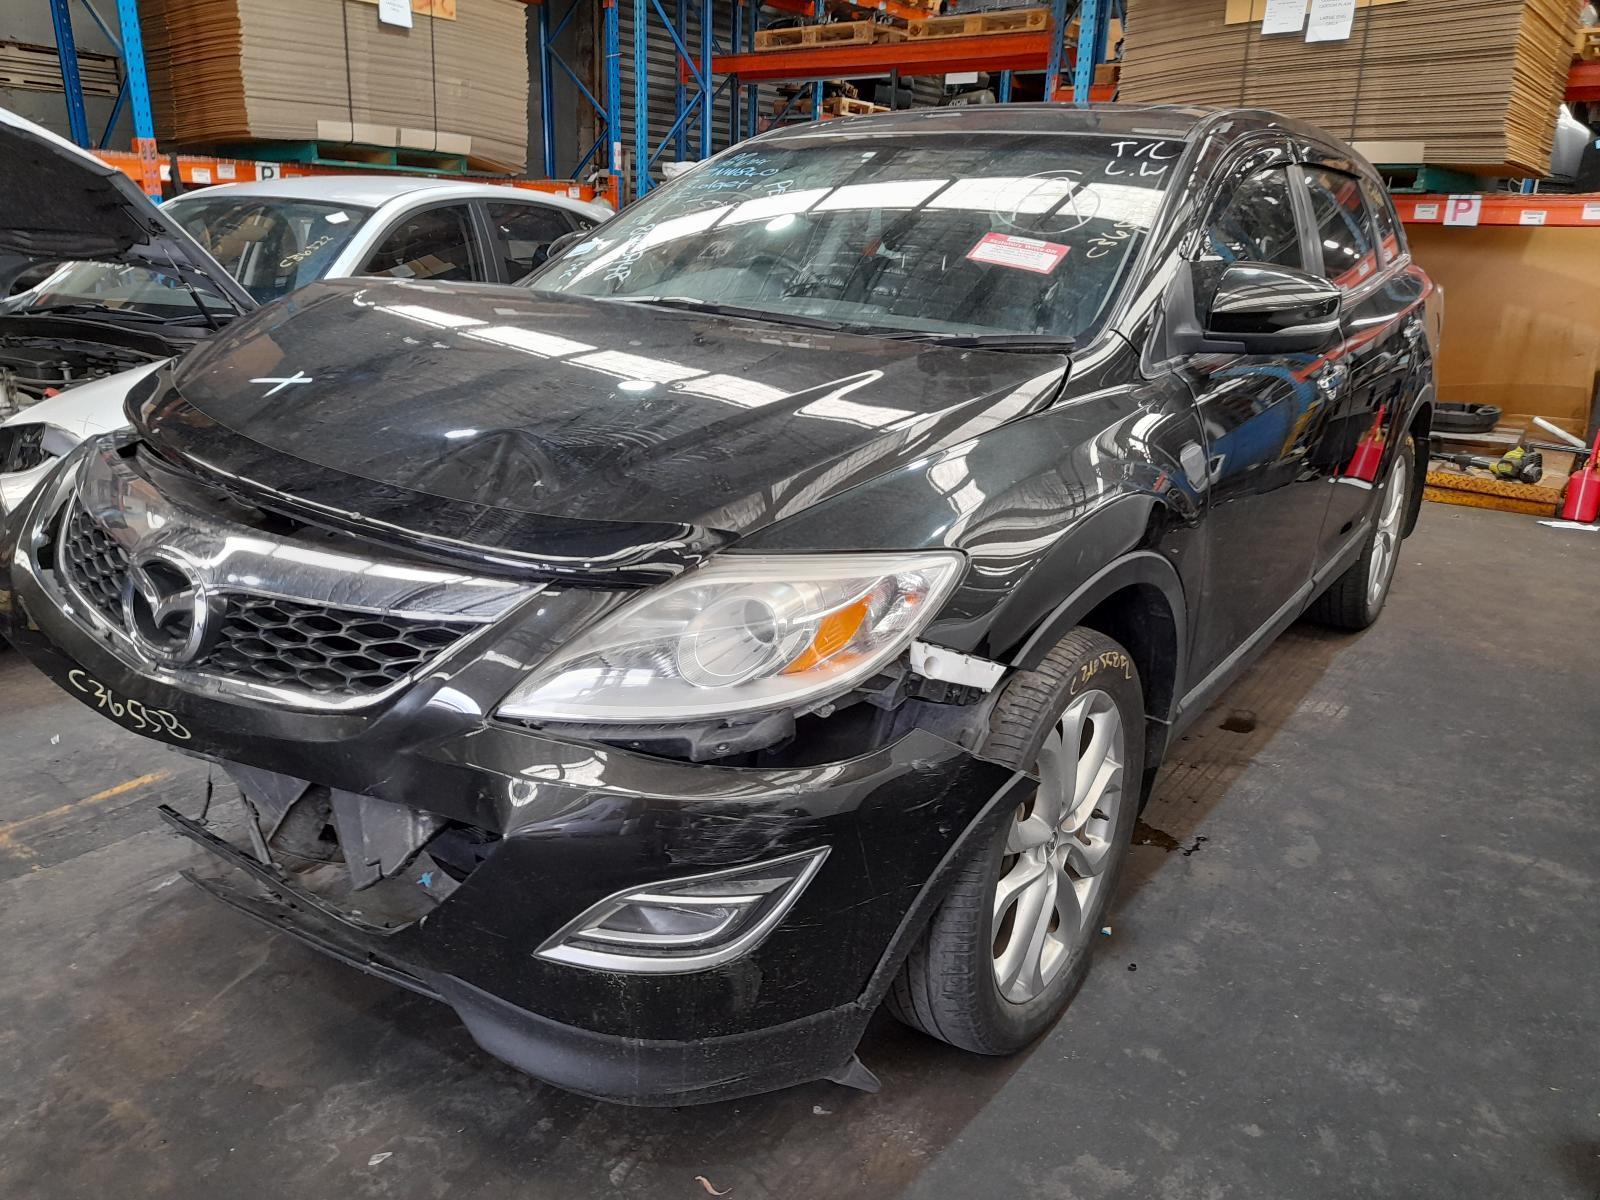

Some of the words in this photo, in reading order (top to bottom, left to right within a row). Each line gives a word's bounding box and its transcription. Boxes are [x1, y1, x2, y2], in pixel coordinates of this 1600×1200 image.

[261, 166, 274, 181] P
[1451, 199, 1473, 222] P
[68, 669, 192, 740] C36558
